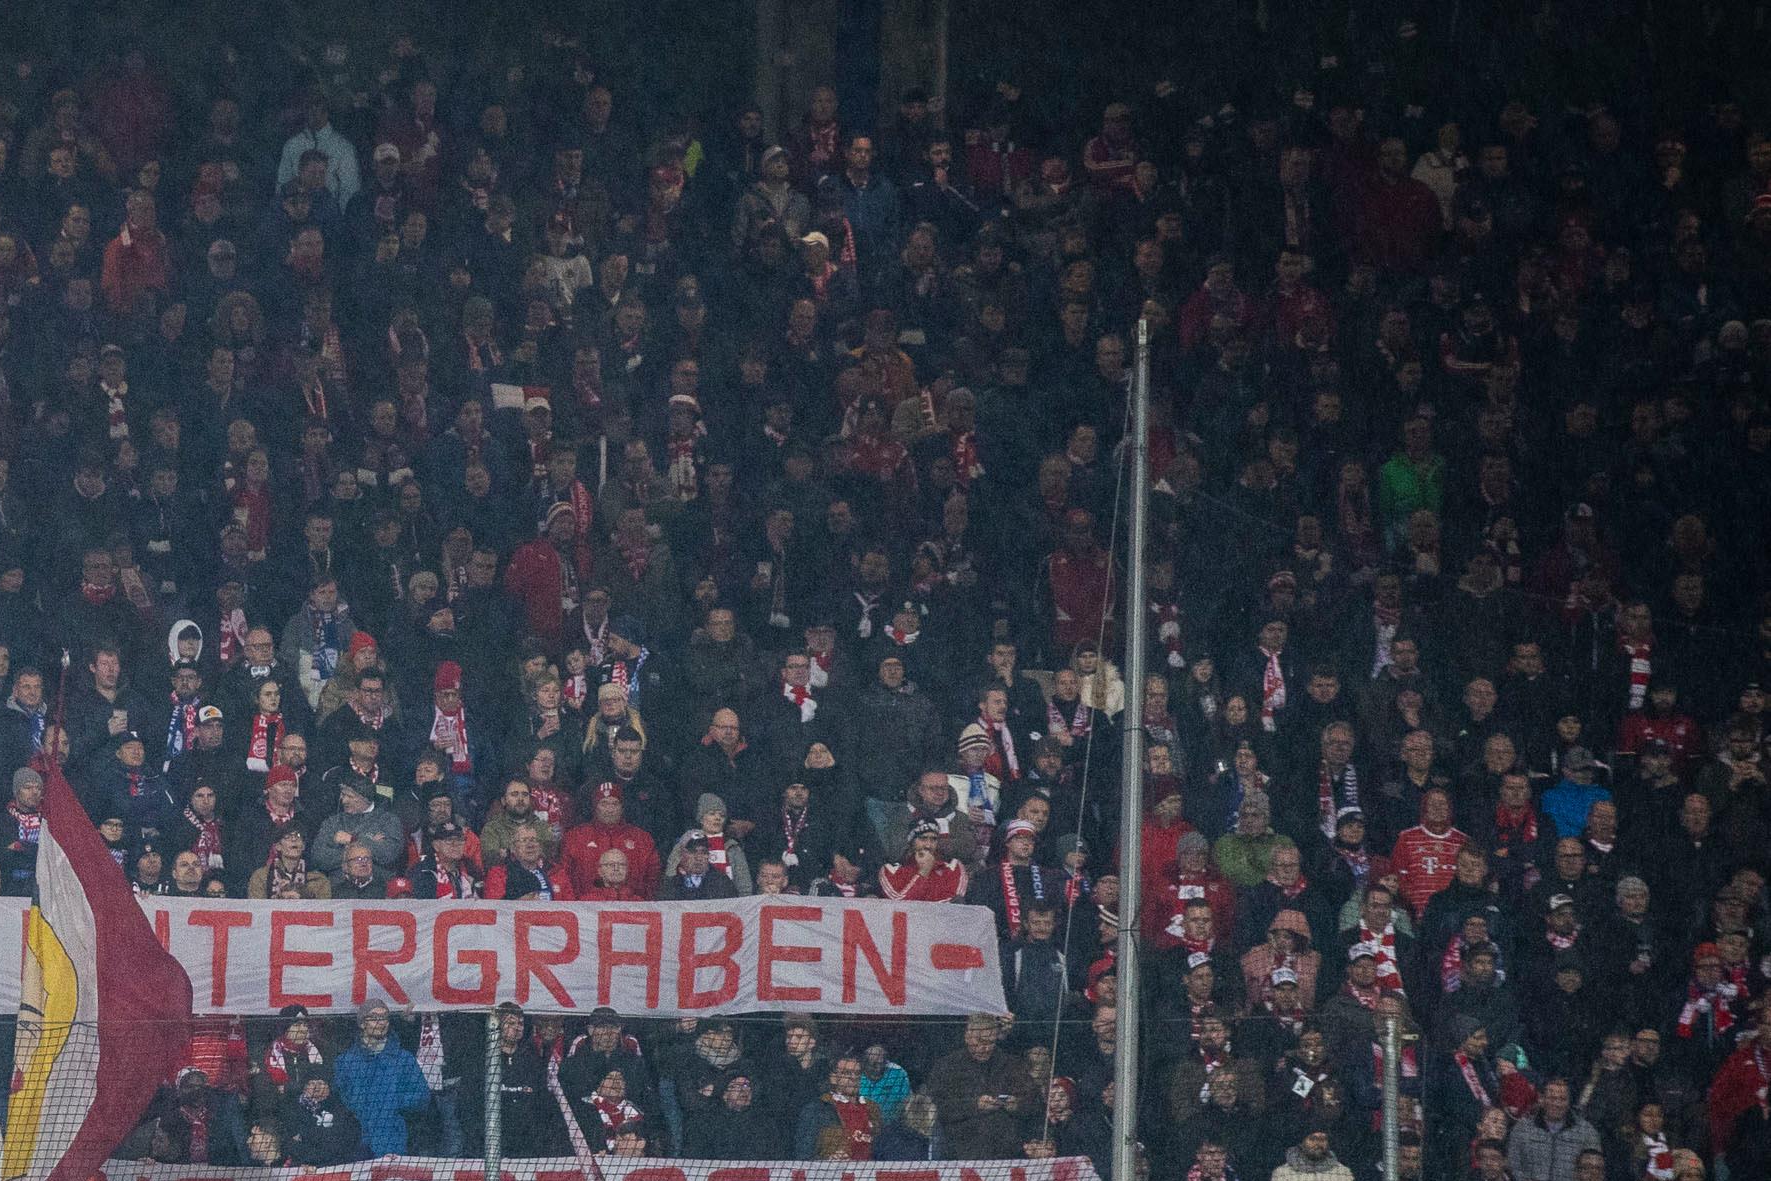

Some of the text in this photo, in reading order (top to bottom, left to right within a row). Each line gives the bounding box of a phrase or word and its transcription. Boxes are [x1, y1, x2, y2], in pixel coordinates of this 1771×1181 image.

[1002, 862, 1021, 924] FC BAYERN
[1031, 865, 1044, 899] BOCH
[23, 905, 985, 1010] TERGRABEN-
